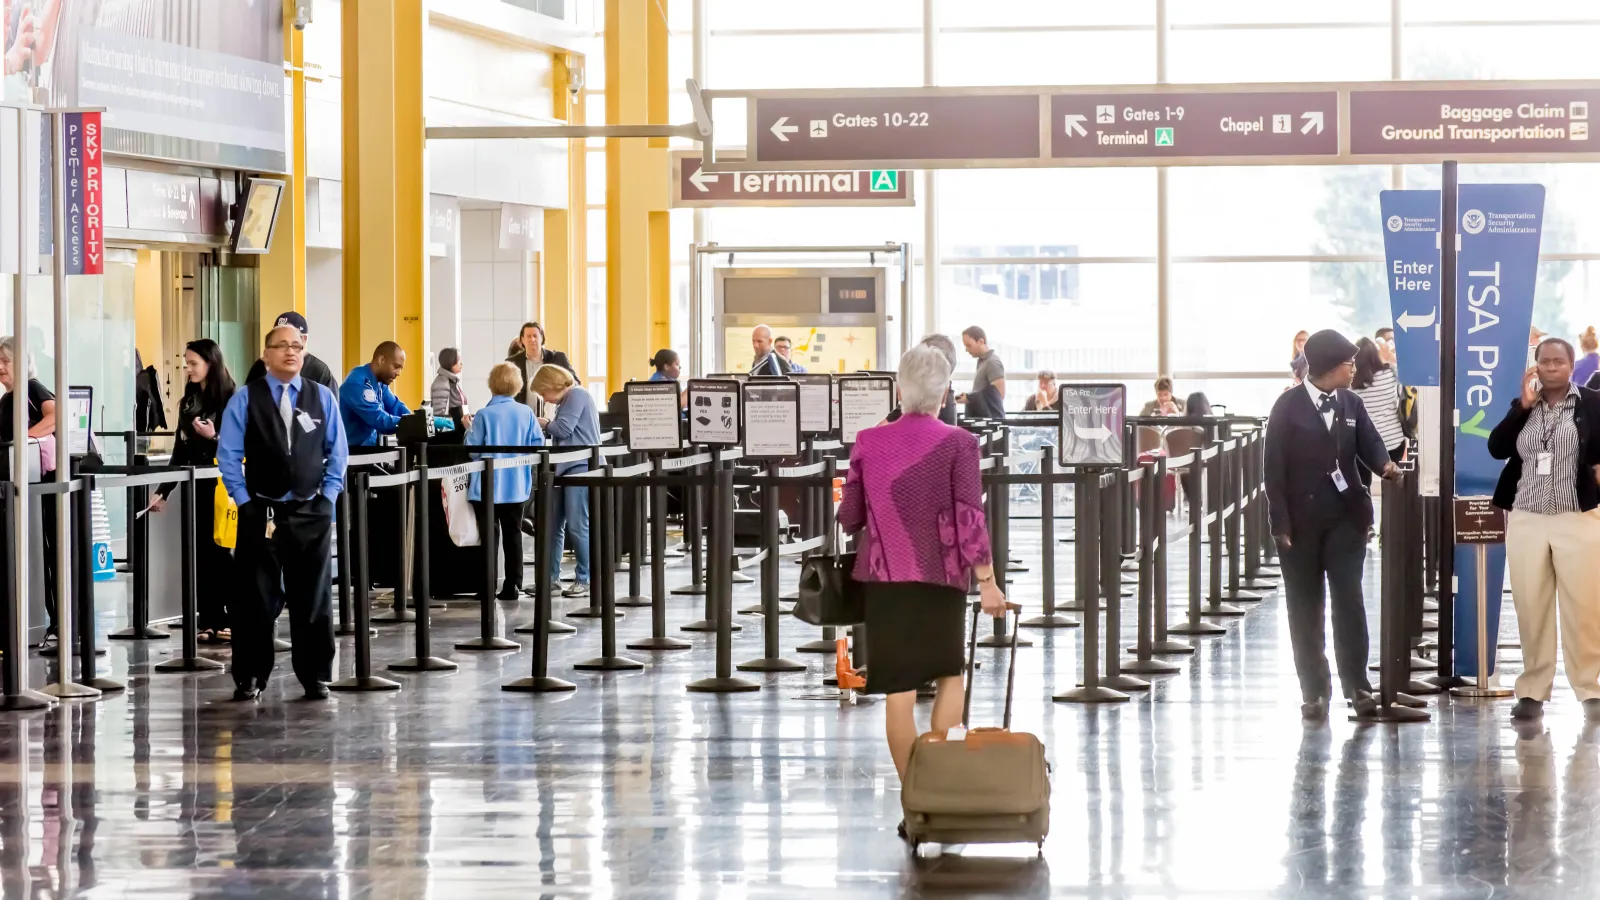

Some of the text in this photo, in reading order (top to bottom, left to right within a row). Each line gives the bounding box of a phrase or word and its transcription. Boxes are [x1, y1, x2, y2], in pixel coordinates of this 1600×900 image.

[181, 58, 193, 83] the
[832, 112, 929, 128] Gates 10-22
[1123, 106, 1185, 121] Gates 1-9
[1440, 102, 1565, 122] Baggage Claim
[1219, 116, 1264, 136] Chapel
[1381, 123, 1565, 143] Ground Transportation
[1096, 129, 1172, 145] Terminal A
[733, 171, 896, 193] Terminal A
[68, 125, 80, 265] Premier Access
[86, 123, 100, 265] SKY PRIORITY
[1488, 212, 1536, 220] Transportation
[1393, 260, 1434, 275] Enter
[1395, 277, 1432, 291] Here
[1466, 261, 1501, 407] TSA Pre
[1068, 405, 1118, 414] Enter Here
